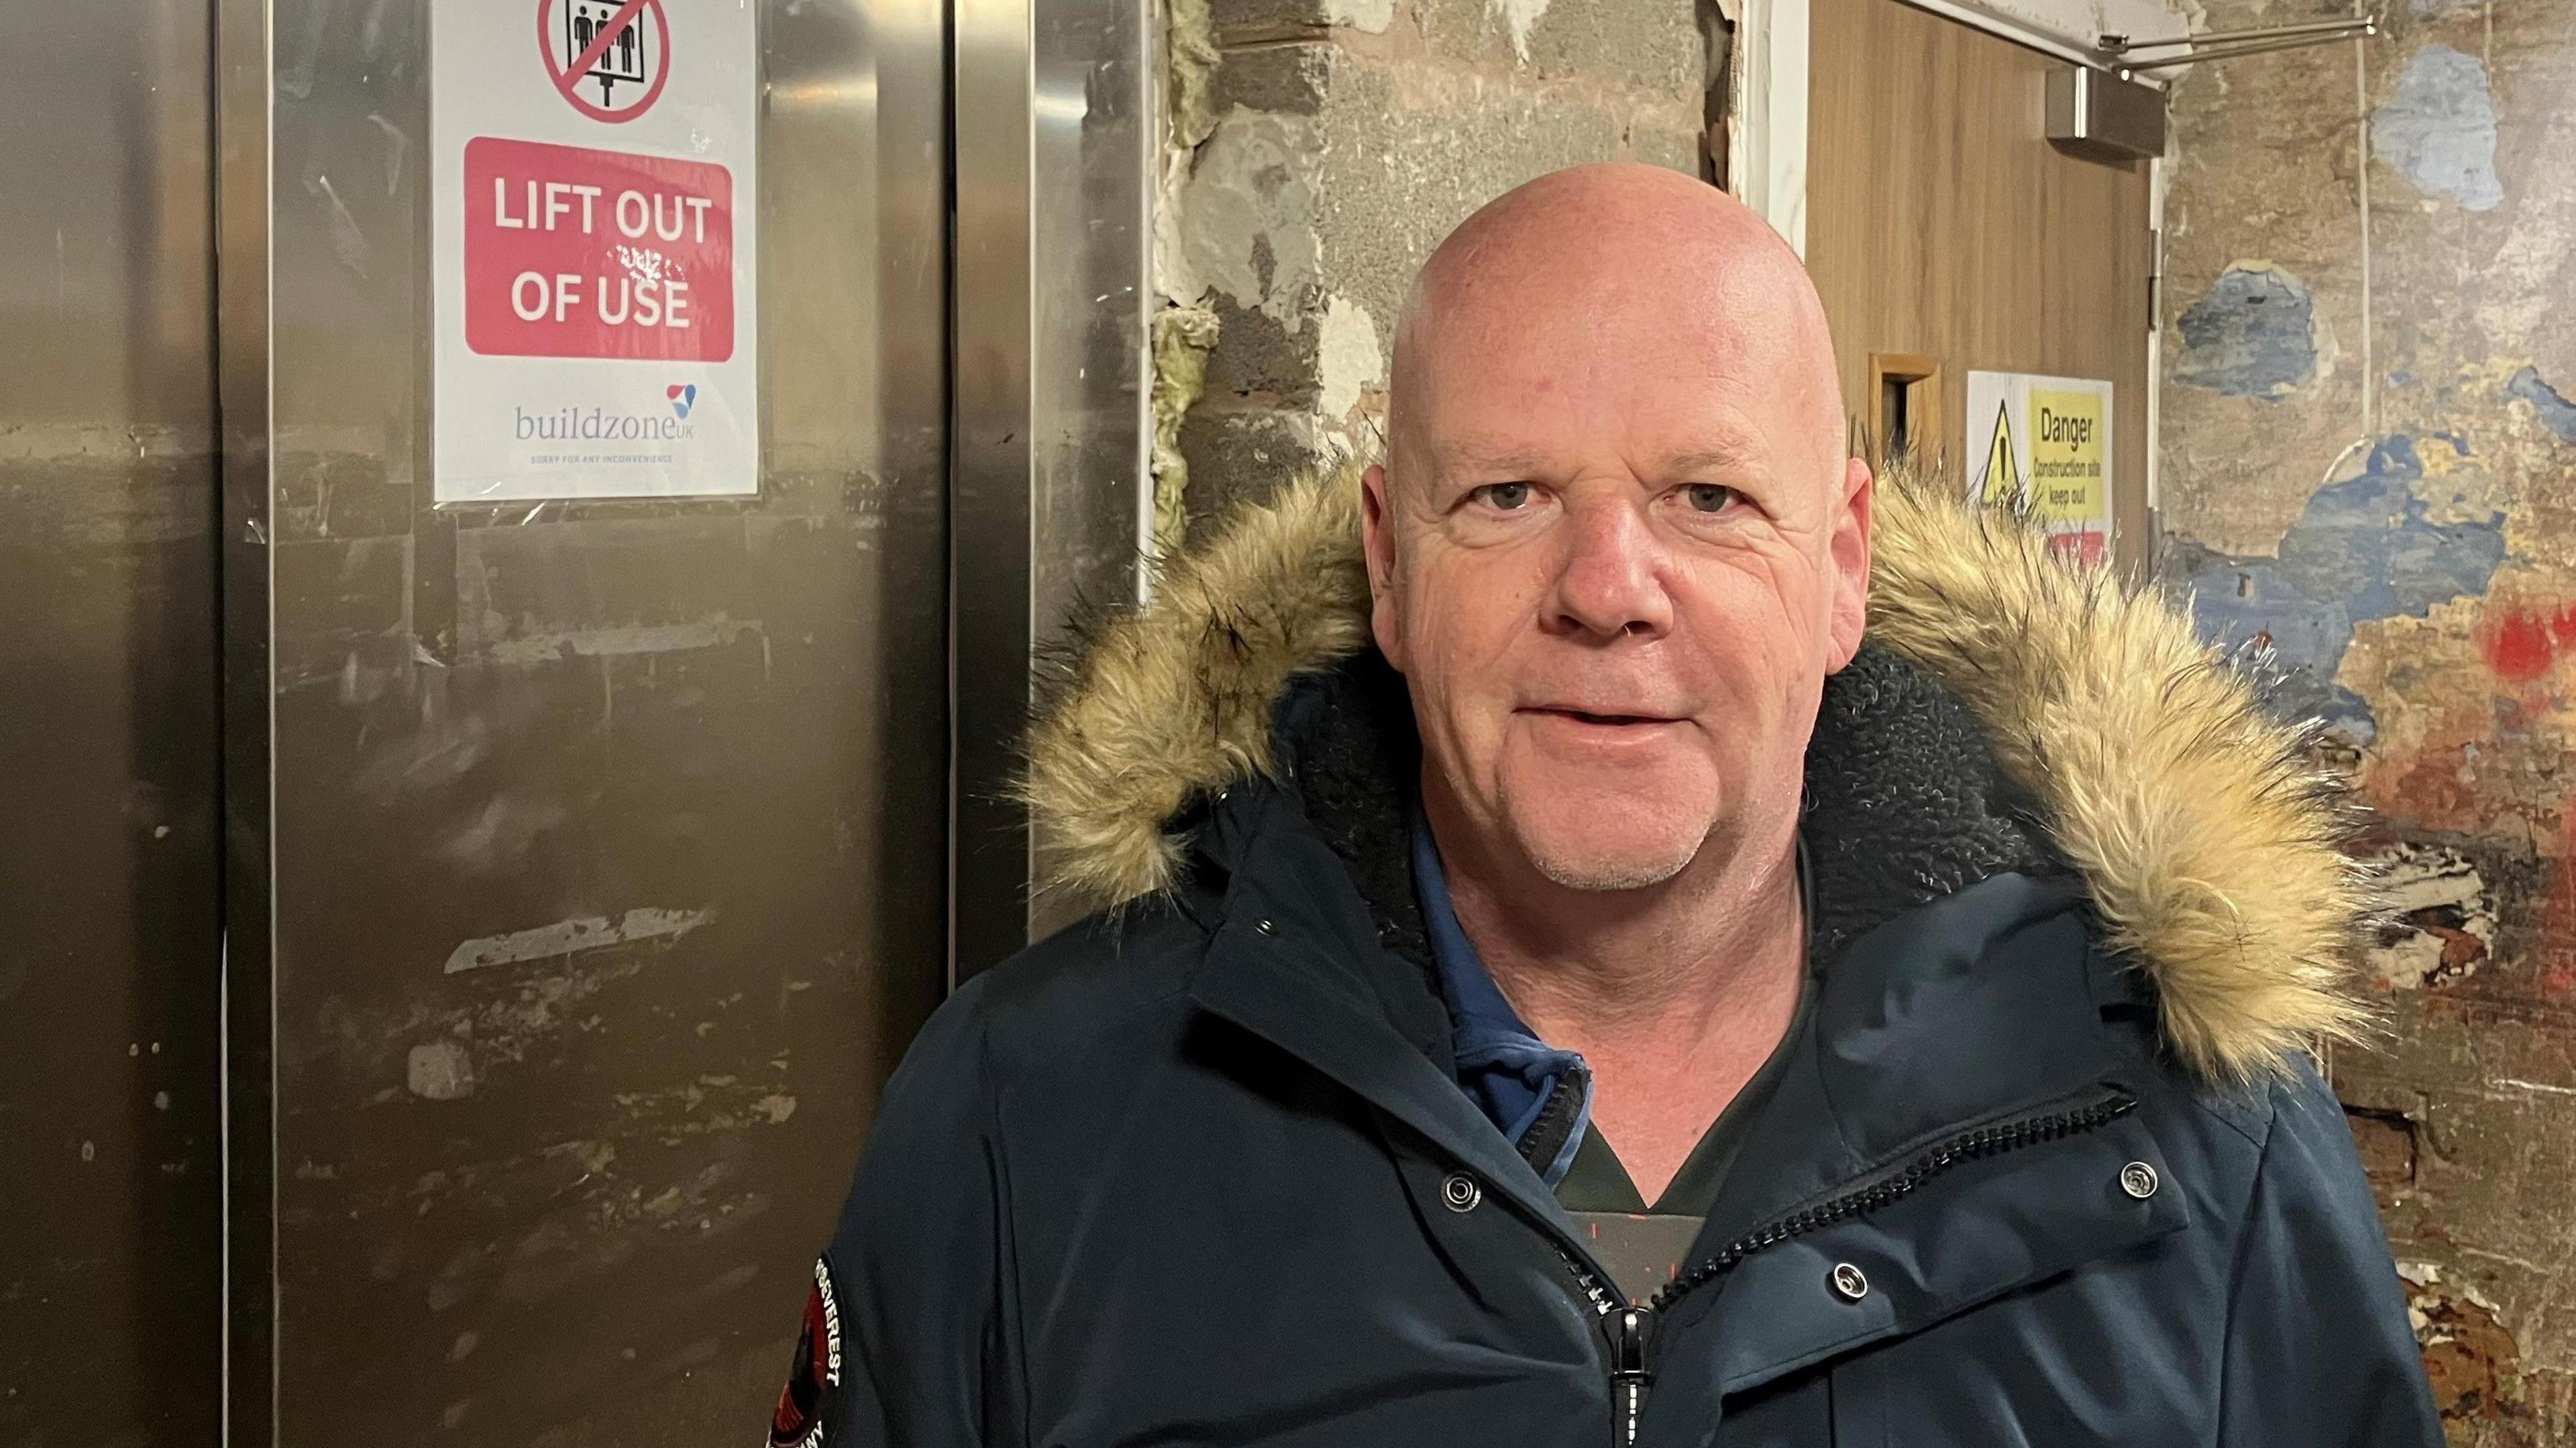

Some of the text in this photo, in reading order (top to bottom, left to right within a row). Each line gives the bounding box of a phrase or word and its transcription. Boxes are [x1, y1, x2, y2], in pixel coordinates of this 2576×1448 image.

[494, 177, 712, 243] LIFT OUT
[511, 271, 690, 328] OF USE
[2041, 406, 2093, 453] Danger
[531, 454, 673, 464] SORRY FOR ANY INCONVENIENCE
[2033, 456, 2101, 478] Construction site
[2049, 485, 2086, 508] keep out
